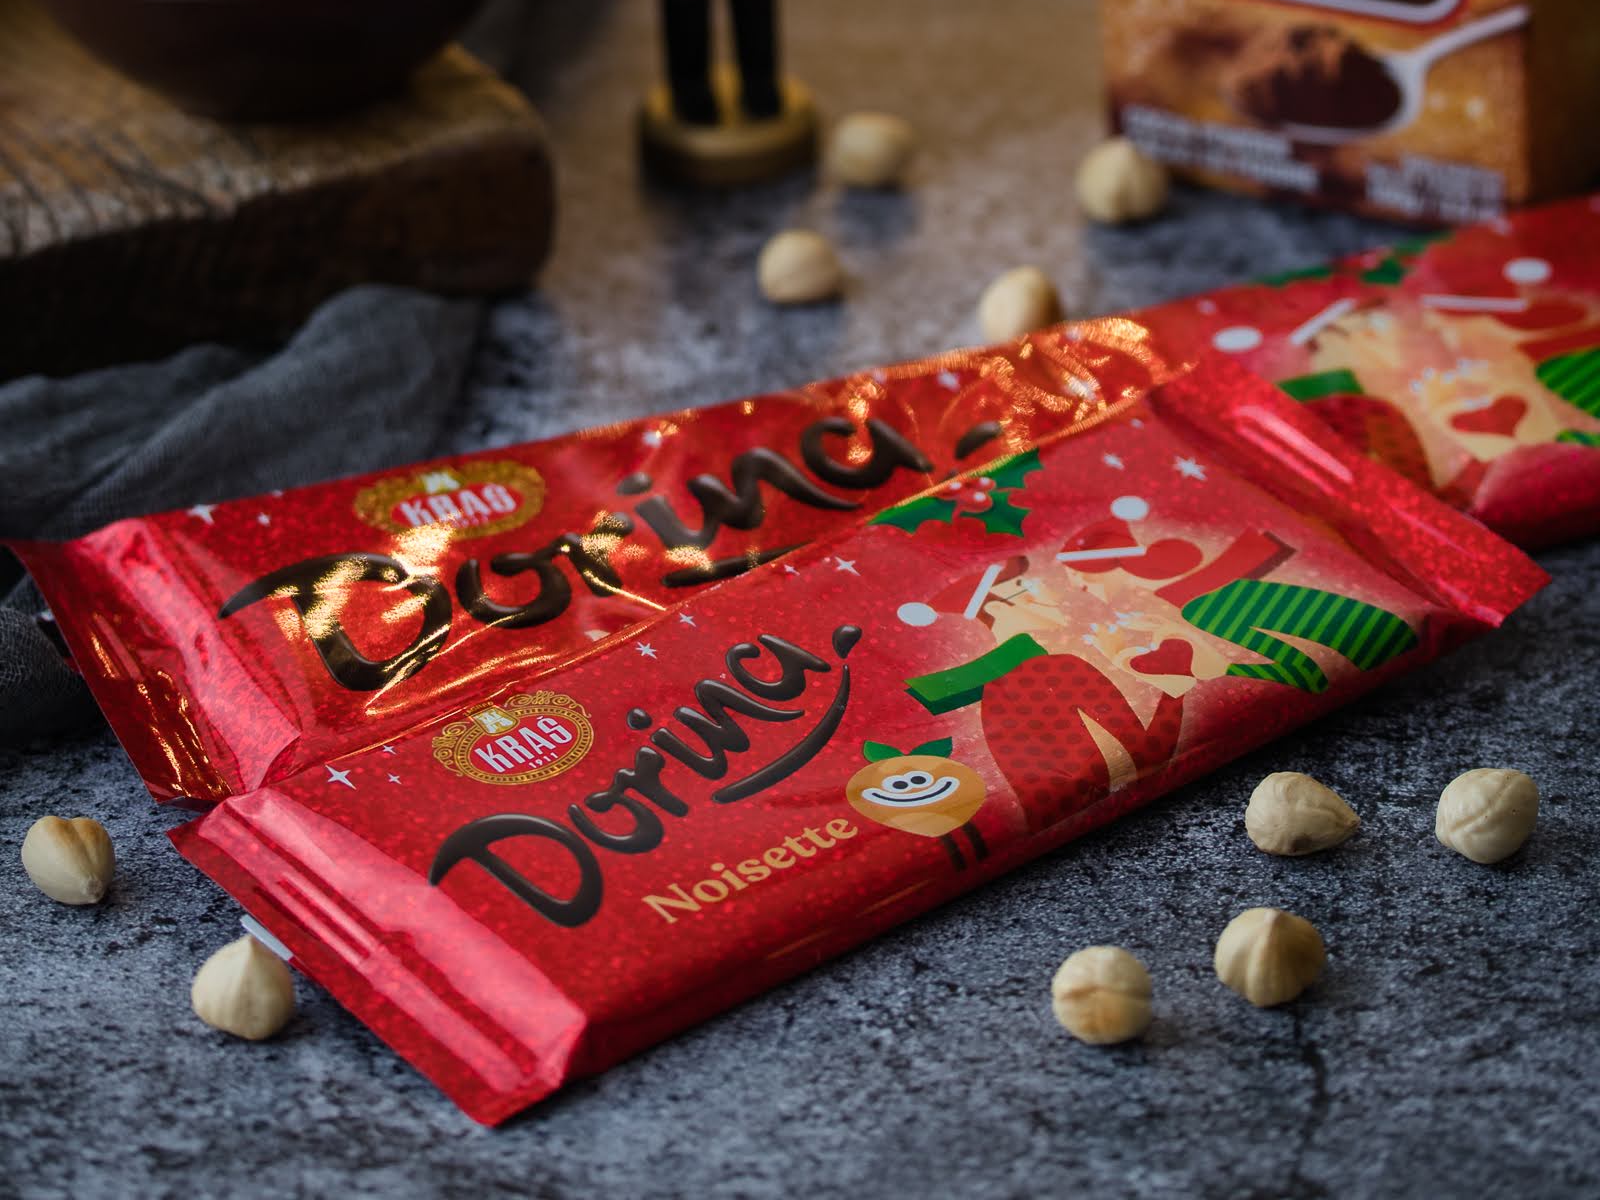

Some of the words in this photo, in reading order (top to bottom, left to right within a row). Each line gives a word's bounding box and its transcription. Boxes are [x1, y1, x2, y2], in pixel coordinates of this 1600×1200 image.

[220, 417, 933, 691] Dorina
[430, 632, 834, 928] Dorina
[474, 715, 573, 773] KRAŠ
[528, 752, 559, 769] 1911
[641, 812, 860, 925] Noisette
